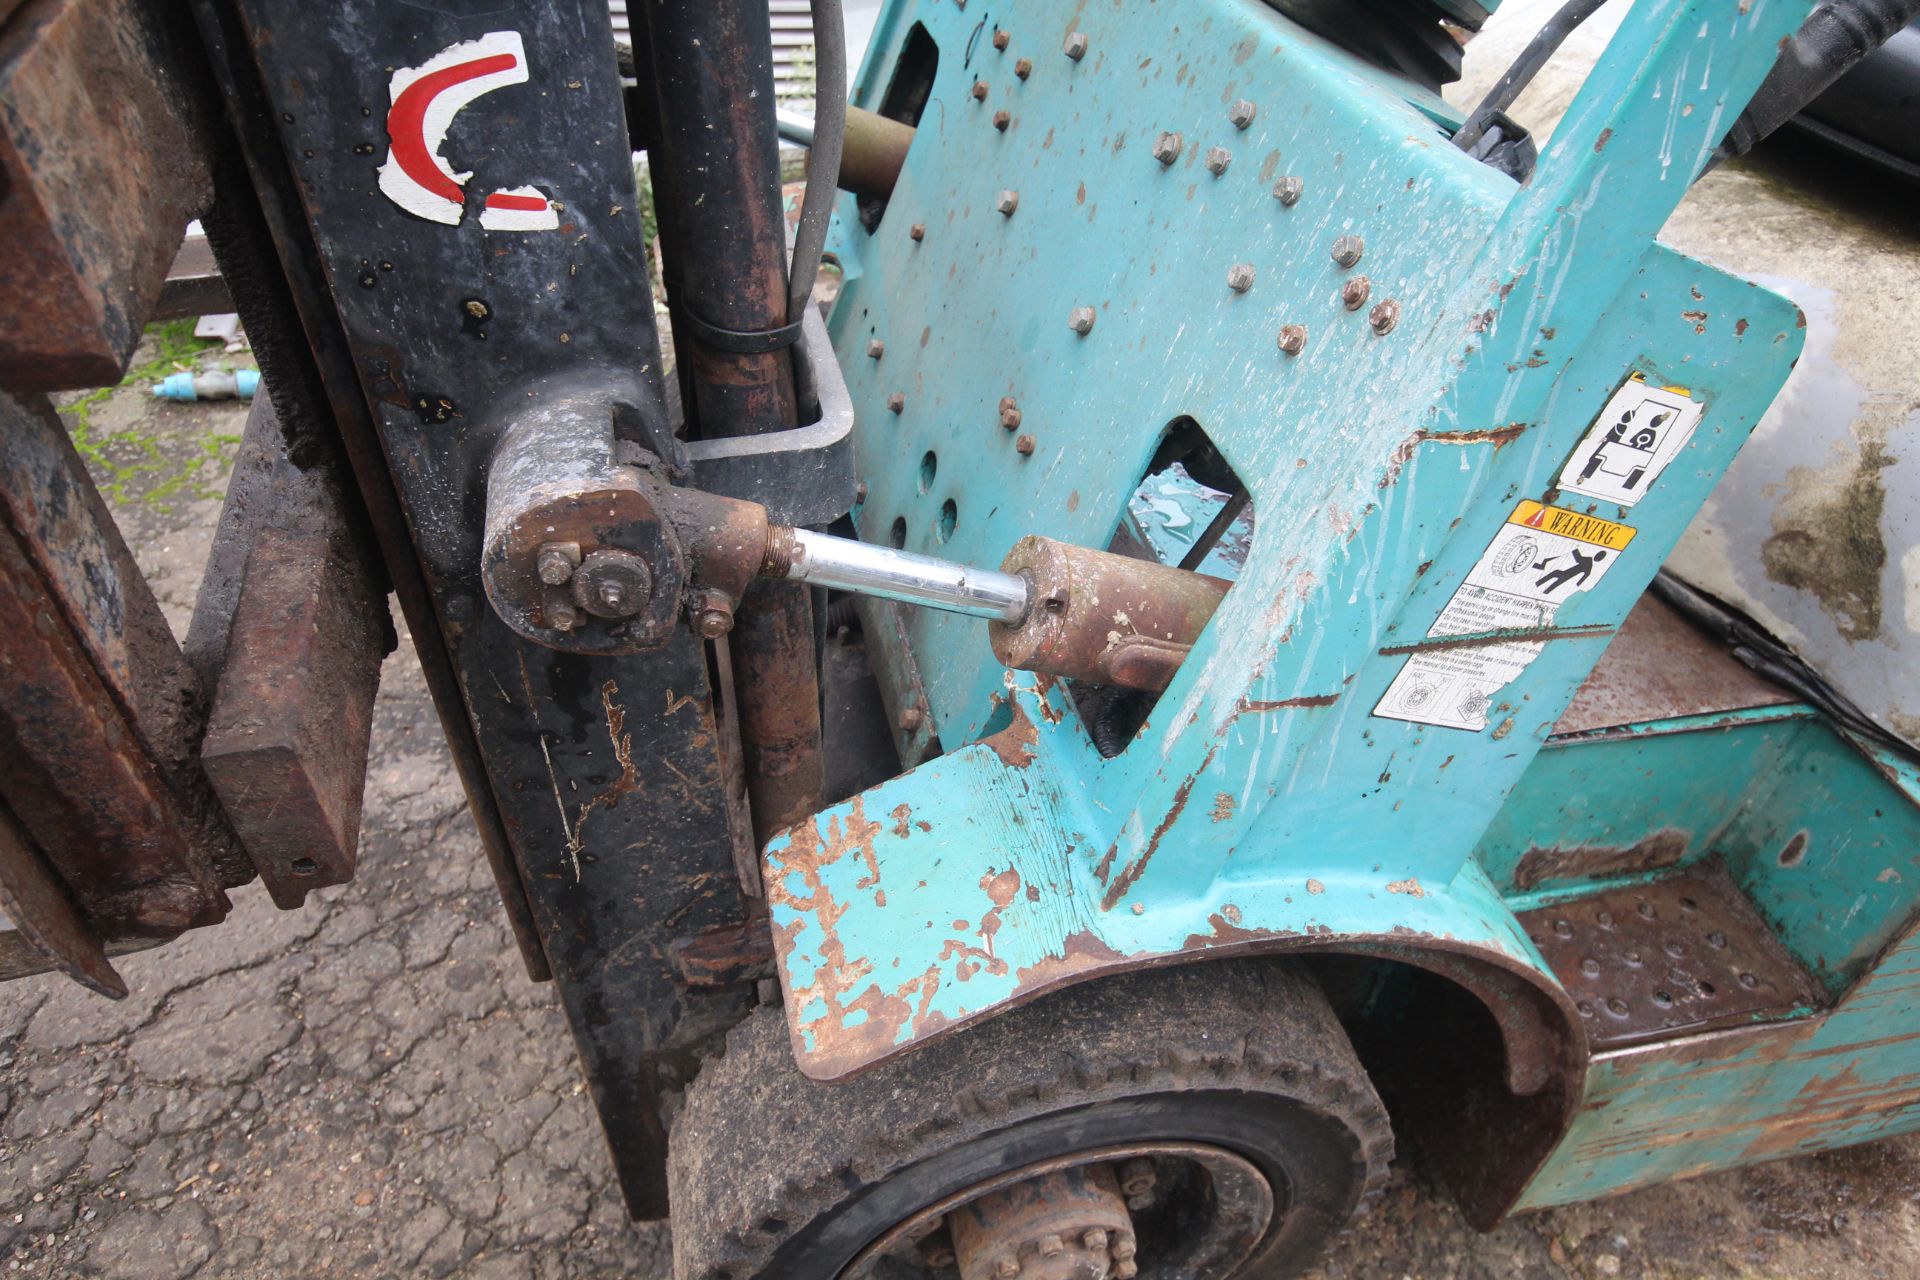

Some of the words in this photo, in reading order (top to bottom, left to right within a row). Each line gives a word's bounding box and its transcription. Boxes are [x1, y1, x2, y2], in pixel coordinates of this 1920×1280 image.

[1550, 511, 1621, 545] WARNING
[1460, 587, 1468, 595] TO
[1484, 593, 1513, 605] ACCIDENT
[1512, 598, 1534, 610] HAPPEN
